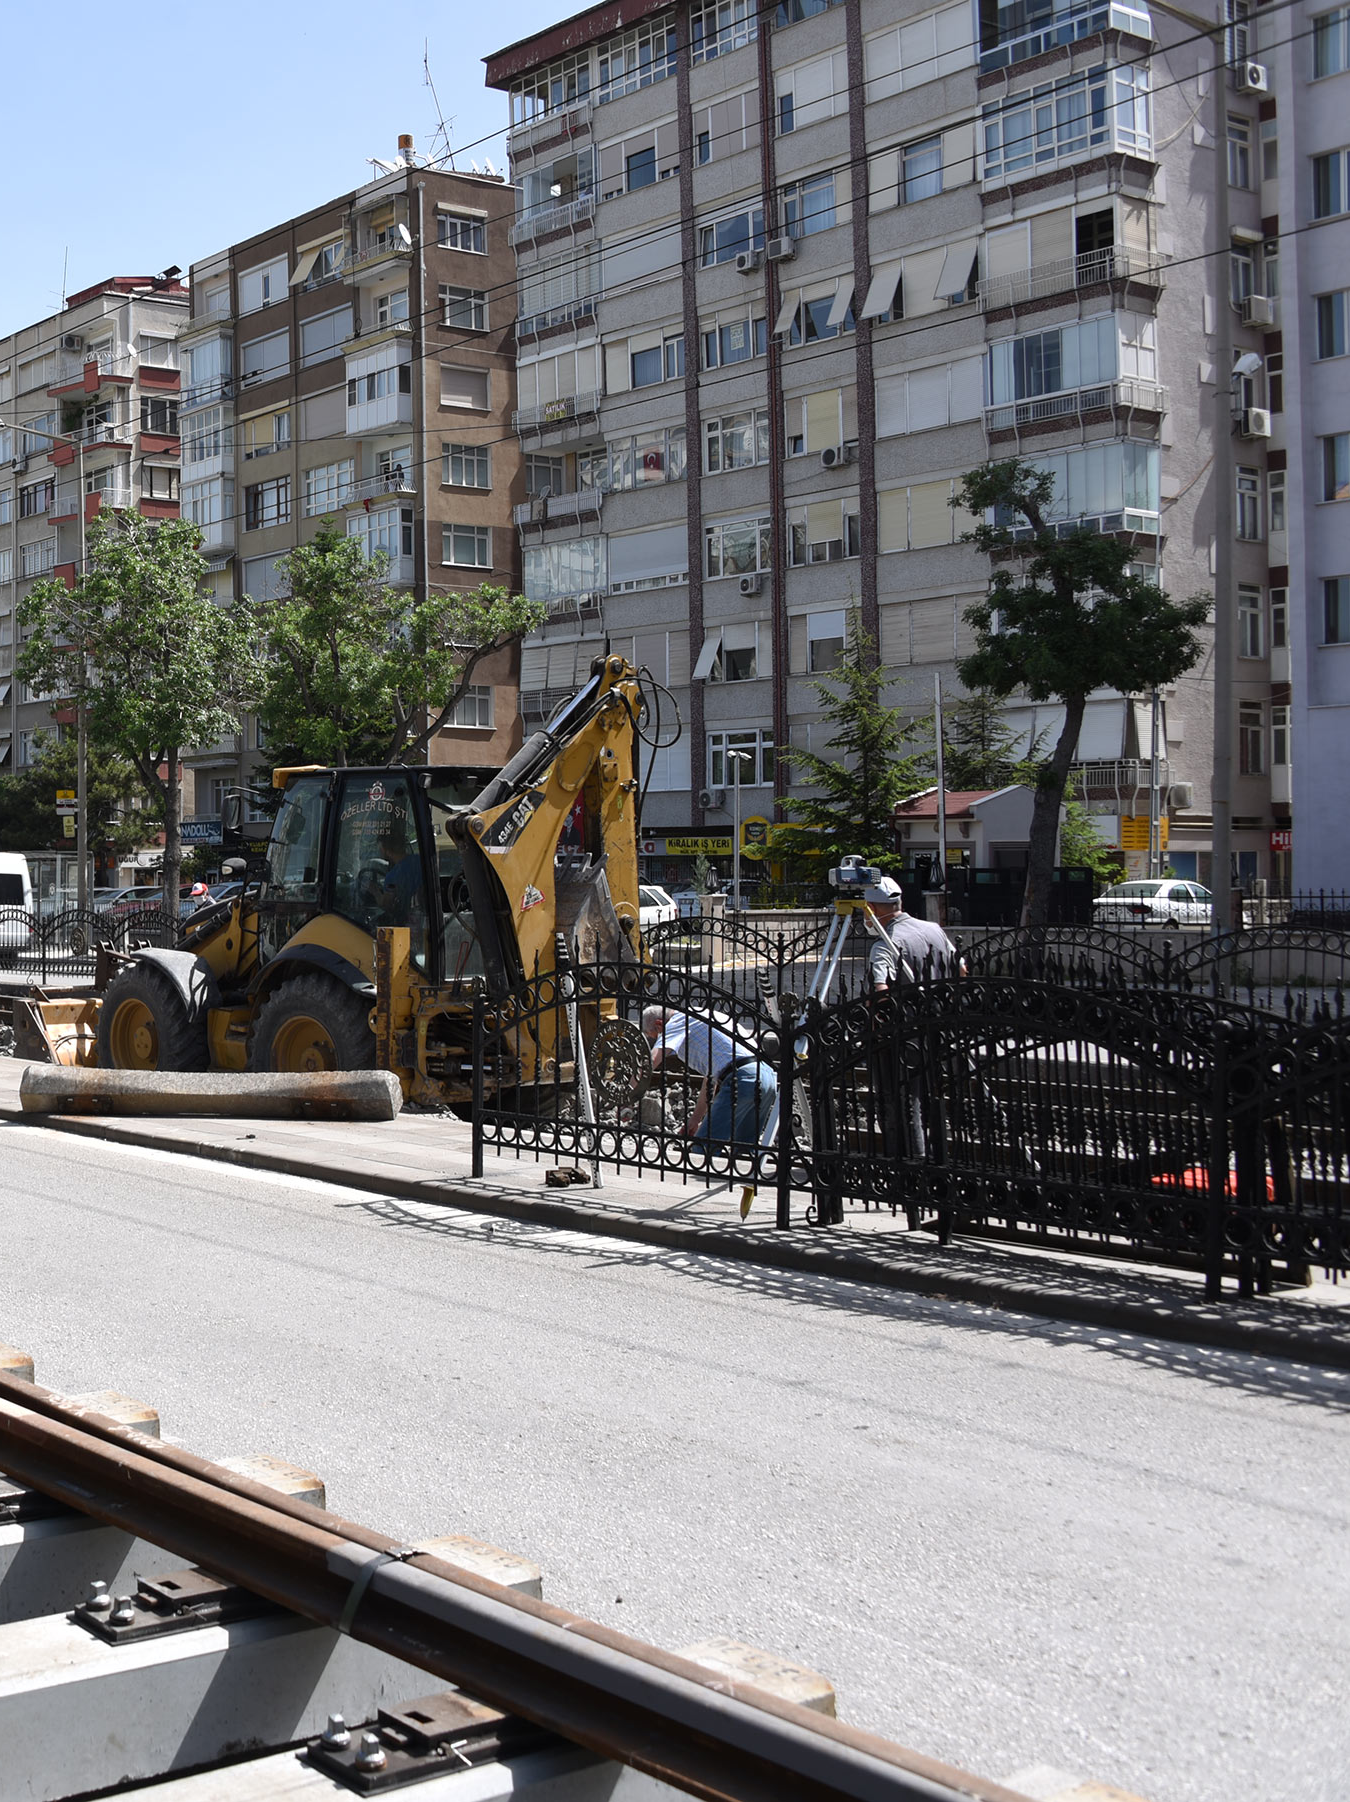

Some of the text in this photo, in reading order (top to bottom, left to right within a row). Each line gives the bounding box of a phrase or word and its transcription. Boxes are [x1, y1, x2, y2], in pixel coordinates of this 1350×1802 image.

[377, 801, 393, 813] LTD
[511, 795, 535, 828] CAT
[180, 823, 209, 837] NADOLU
[498, 821, 514, 844] 434E
